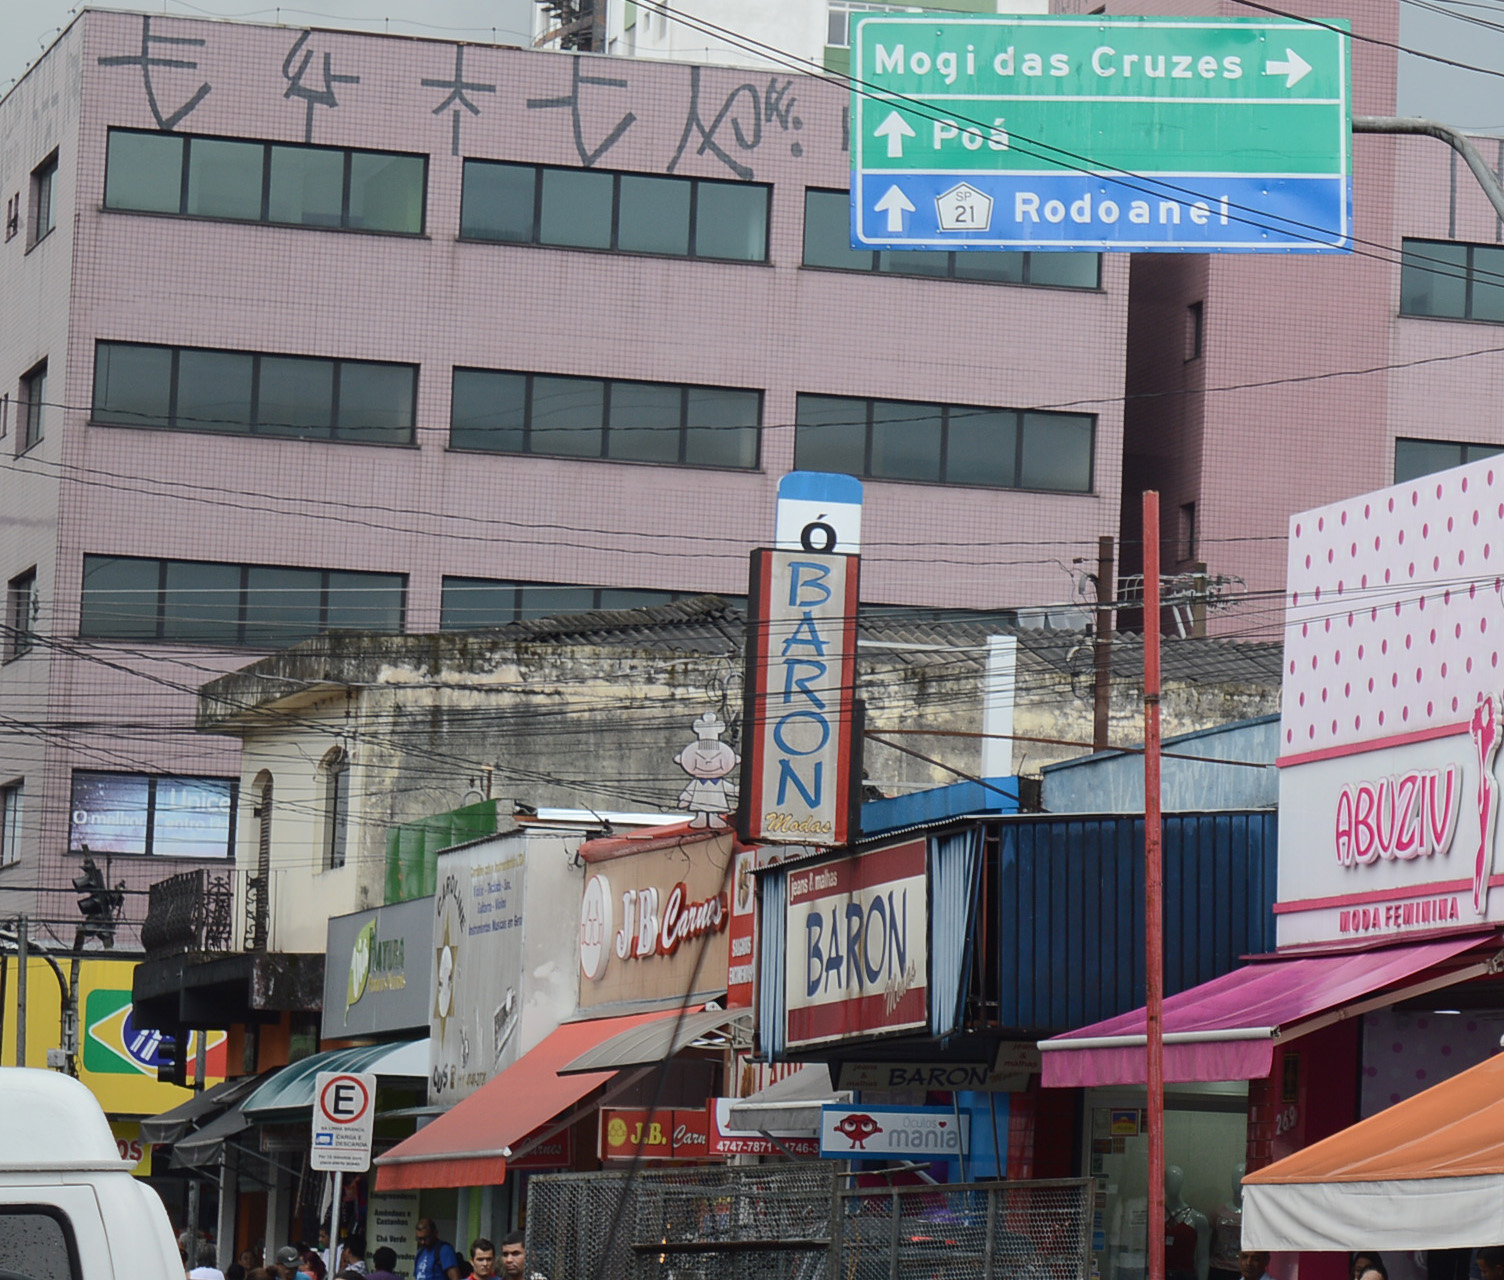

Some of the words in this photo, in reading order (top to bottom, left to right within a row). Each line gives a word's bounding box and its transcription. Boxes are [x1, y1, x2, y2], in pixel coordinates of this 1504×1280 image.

[875, 44, 975, 84] Mogi
[994, 46, 1069, 76] das
[1092, 46, 1243, 79] Cruzes
[933, 117, 1009, 151] Poá
[955, 191, 972, 202] SP
[954, 205, 976, 224] 21
[773, 561, 832, 810] BARON
[765, 811, 832, 834] Modas
[1335, 765, 1462, 866] ABUZIV
[1340, 907, 1381, 932] MODA
[1385, 897, 1459, 927] FEMININA
[806, 887, 907, 998] BARON
[889, 1067, 988, 1087] BARON
[334, 1085, 355, 1114] E
[630, 1122, 667, 1145] J.B.
[1276, 1105, 1297, 1136] 269
[717, 1140, 772, 1153] 4747-7871
[889, 1129, 958, 1149] mania
